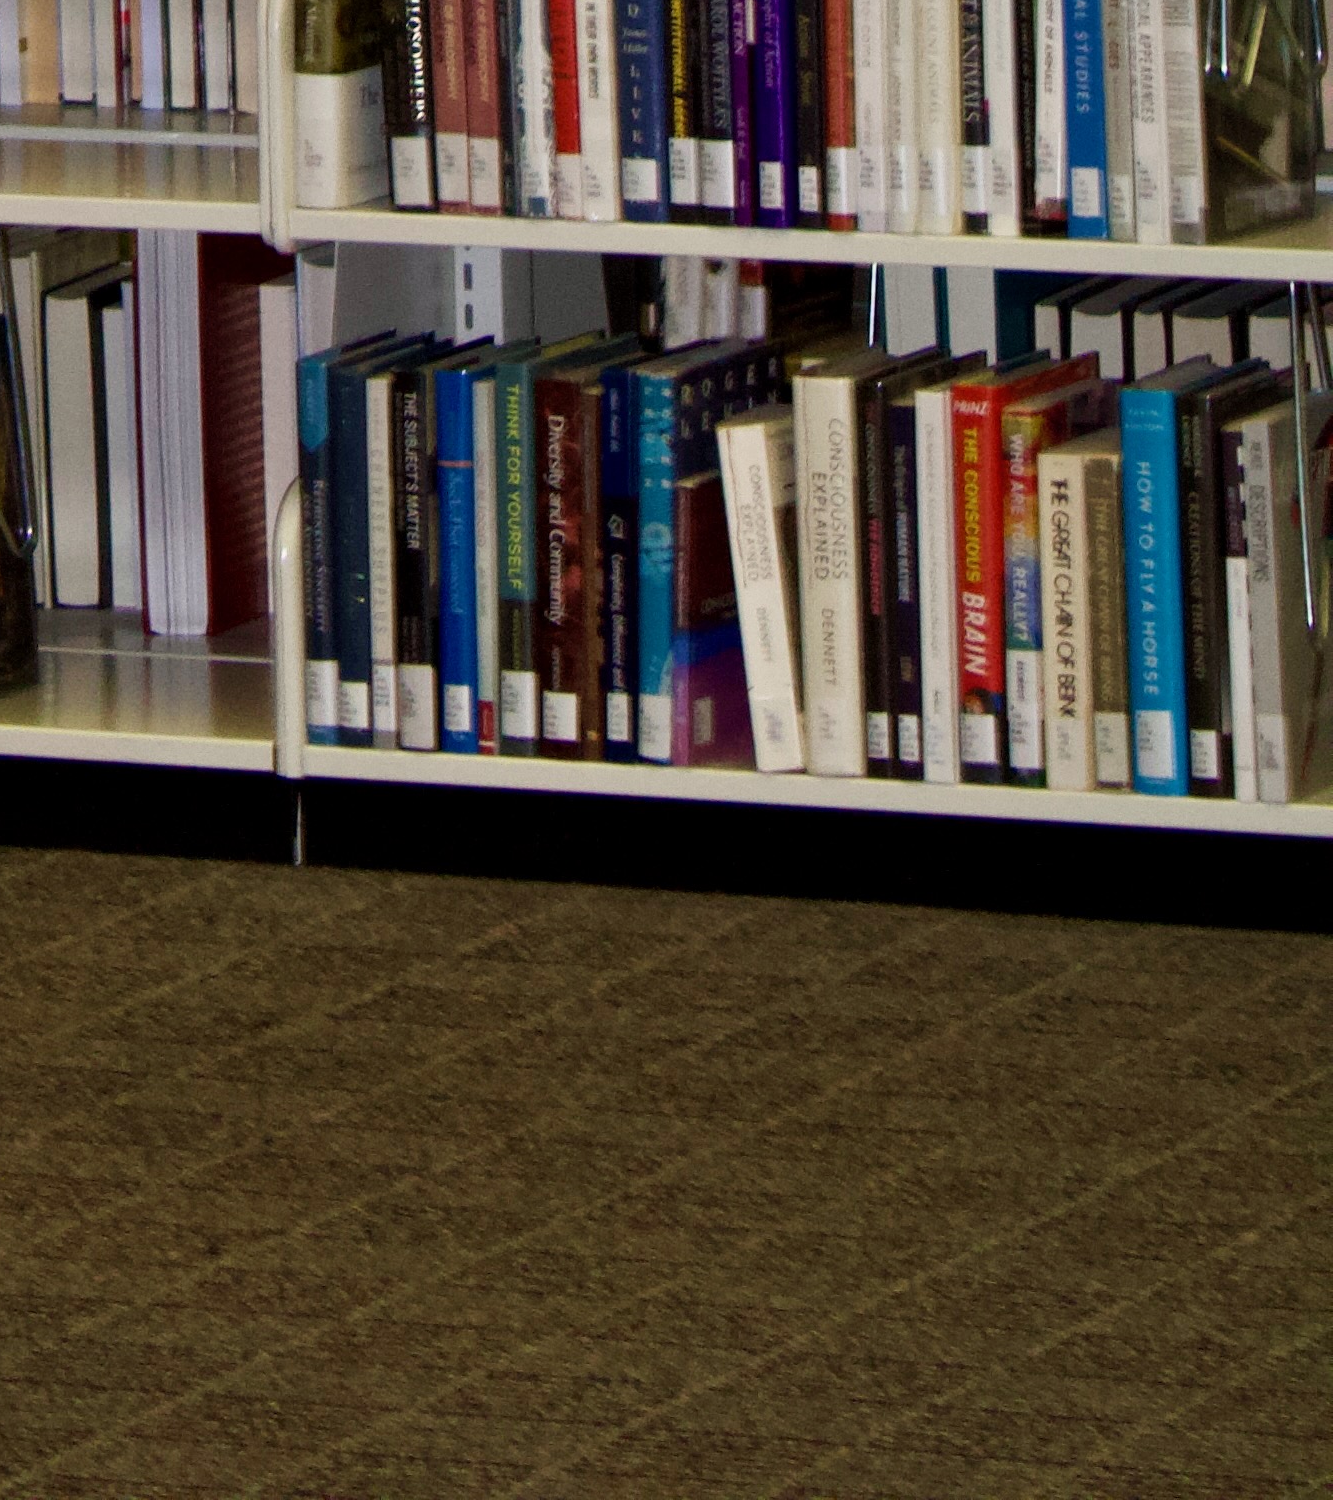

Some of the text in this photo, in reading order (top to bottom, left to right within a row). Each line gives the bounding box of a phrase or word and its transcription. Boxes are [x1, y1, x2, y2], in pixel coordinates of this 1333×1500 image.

[733, 0, 746, 55] ACTION
[1077, 31, 1090, 112] STUDIES
[506, 384, 522, 589] THINK FOR YOURSELF
[1009, 435, 1023, 474] WHO
[547, 416, 567, 625] Diversity and Community
[813, 473, 828, 579] EXPLAINED
[828, 419, 846, 579] CONSCIOUSNESS
[1051, 511, 1070, 568] GREAT
[962, 428, 988, 676] THE CONSCIOUS BRAIN
[1137, 461, 1159, 695] HOW TO FLY A HORSE
[1054, 574, 1073, 637] CHAIN
[822, 608, 836, 685] DENNETT
[1057, 644, 1074, 668] OF
